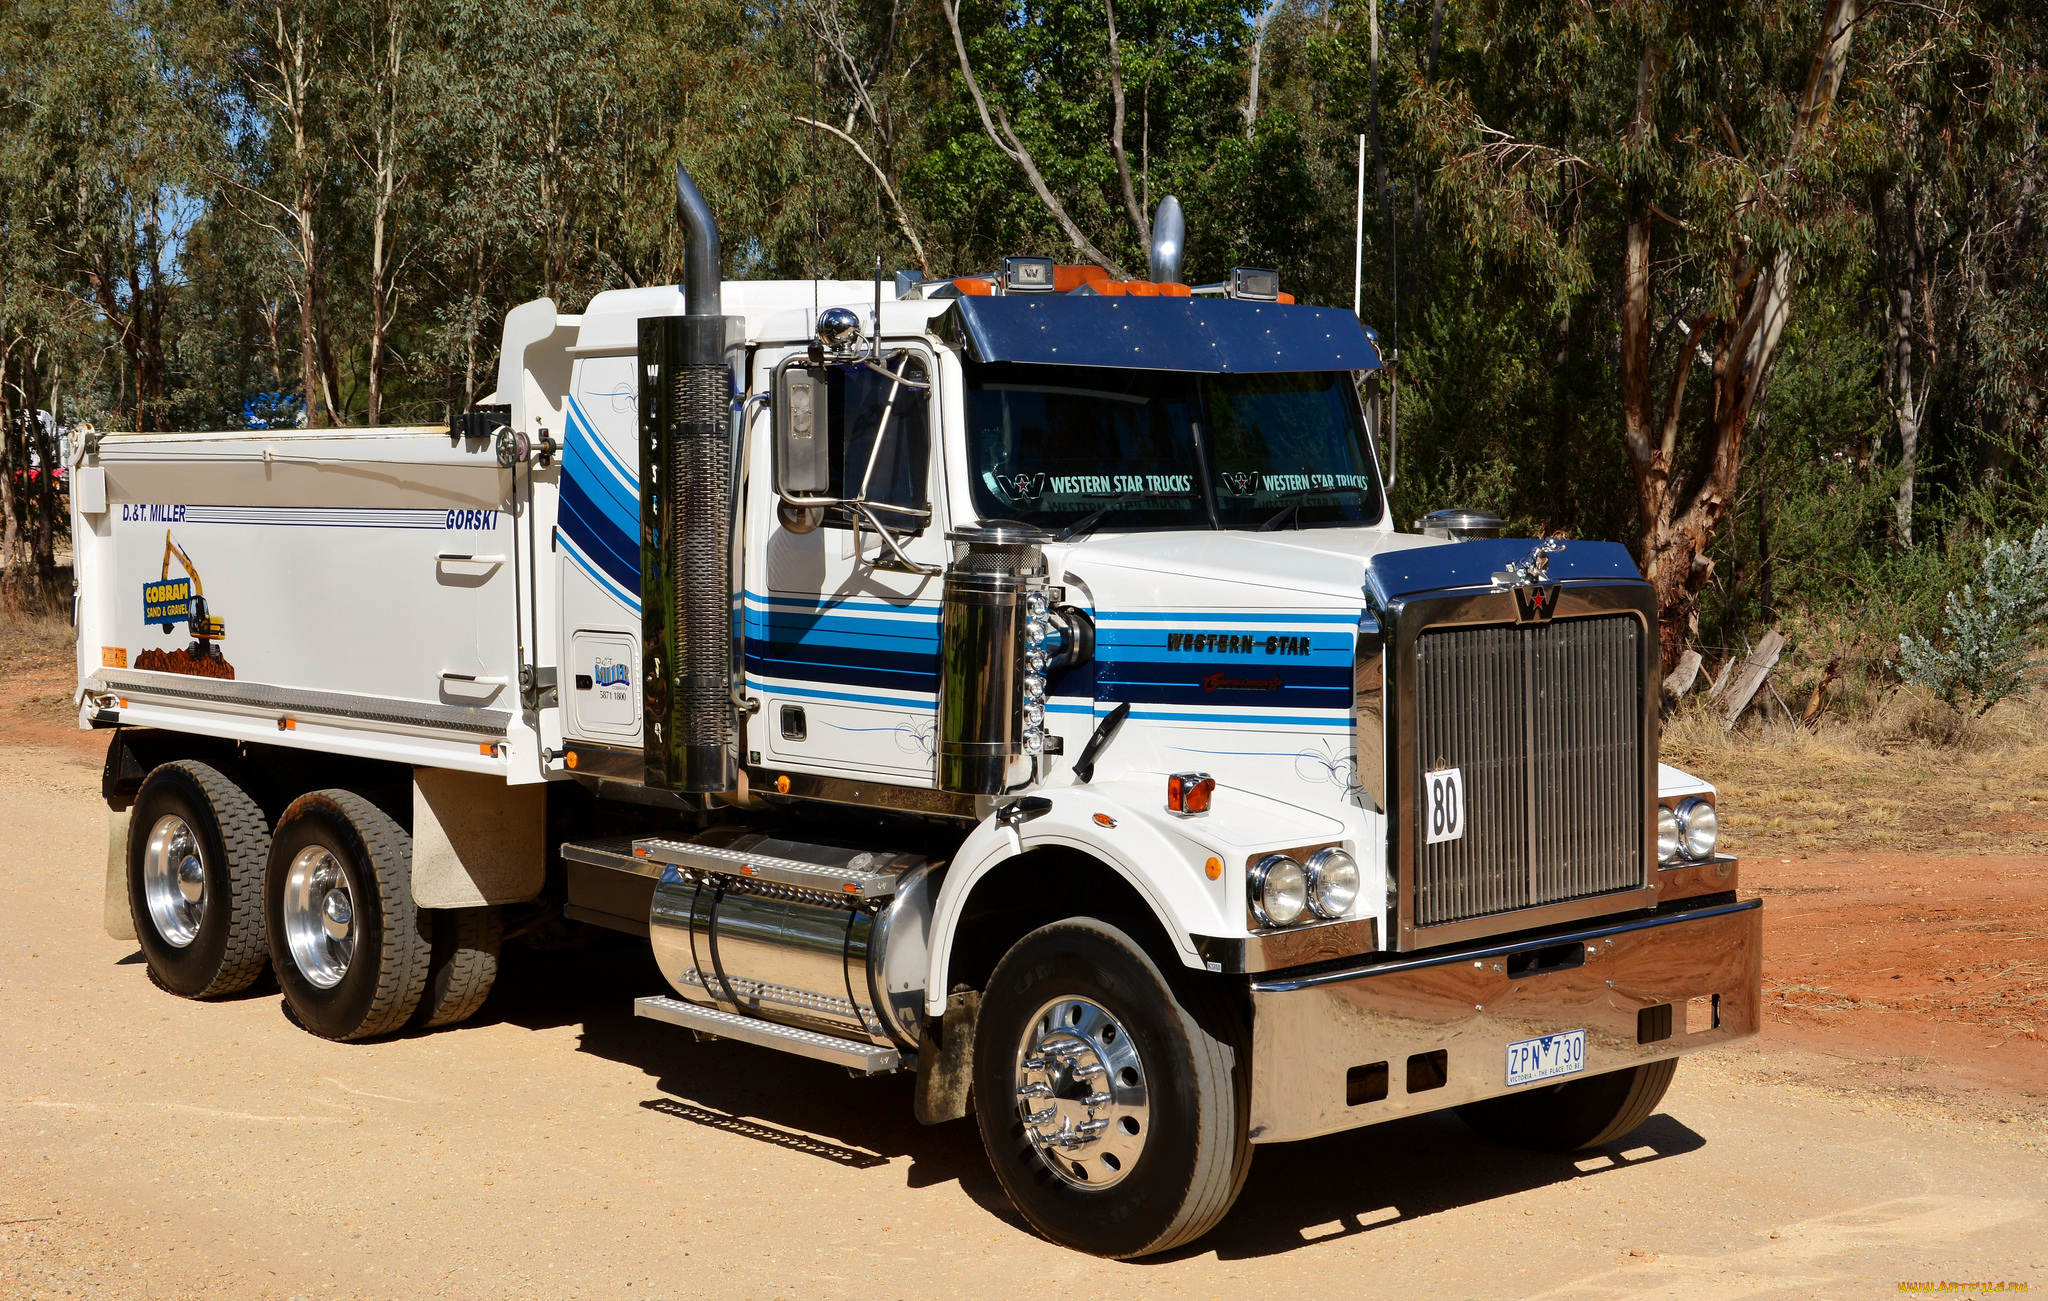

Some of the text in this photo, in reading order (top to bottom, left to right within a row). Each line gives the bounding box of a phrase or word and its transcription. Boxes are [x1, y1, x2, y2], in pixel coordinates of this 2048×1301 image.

[1050, 474, 1191, 494] WESTERN STAR TRUCKS
[1262, 474, 1368, 491] WESTERN STAR TRUCKS
[149, 504, 186, 522] MILLER
[446, 509, 498, 530] GORSKI
[145, 583, 188, 603] COBRAM
[147, 603, 189, 618] SAND & GRAVEL
[1167, 633, 1310, 656] WESTERN STAR
[595, 664, 630, 685] MILLER
[1433, 776, 1457, 836] 80
[1510, 1036, 1581, 1075] ZPN 730
[1509, 1072, 1532, 1083] VICTORIA
[1538, 1069, 1548, 1077] THE
[1549, 1065, 1564, 1075] PLACE
